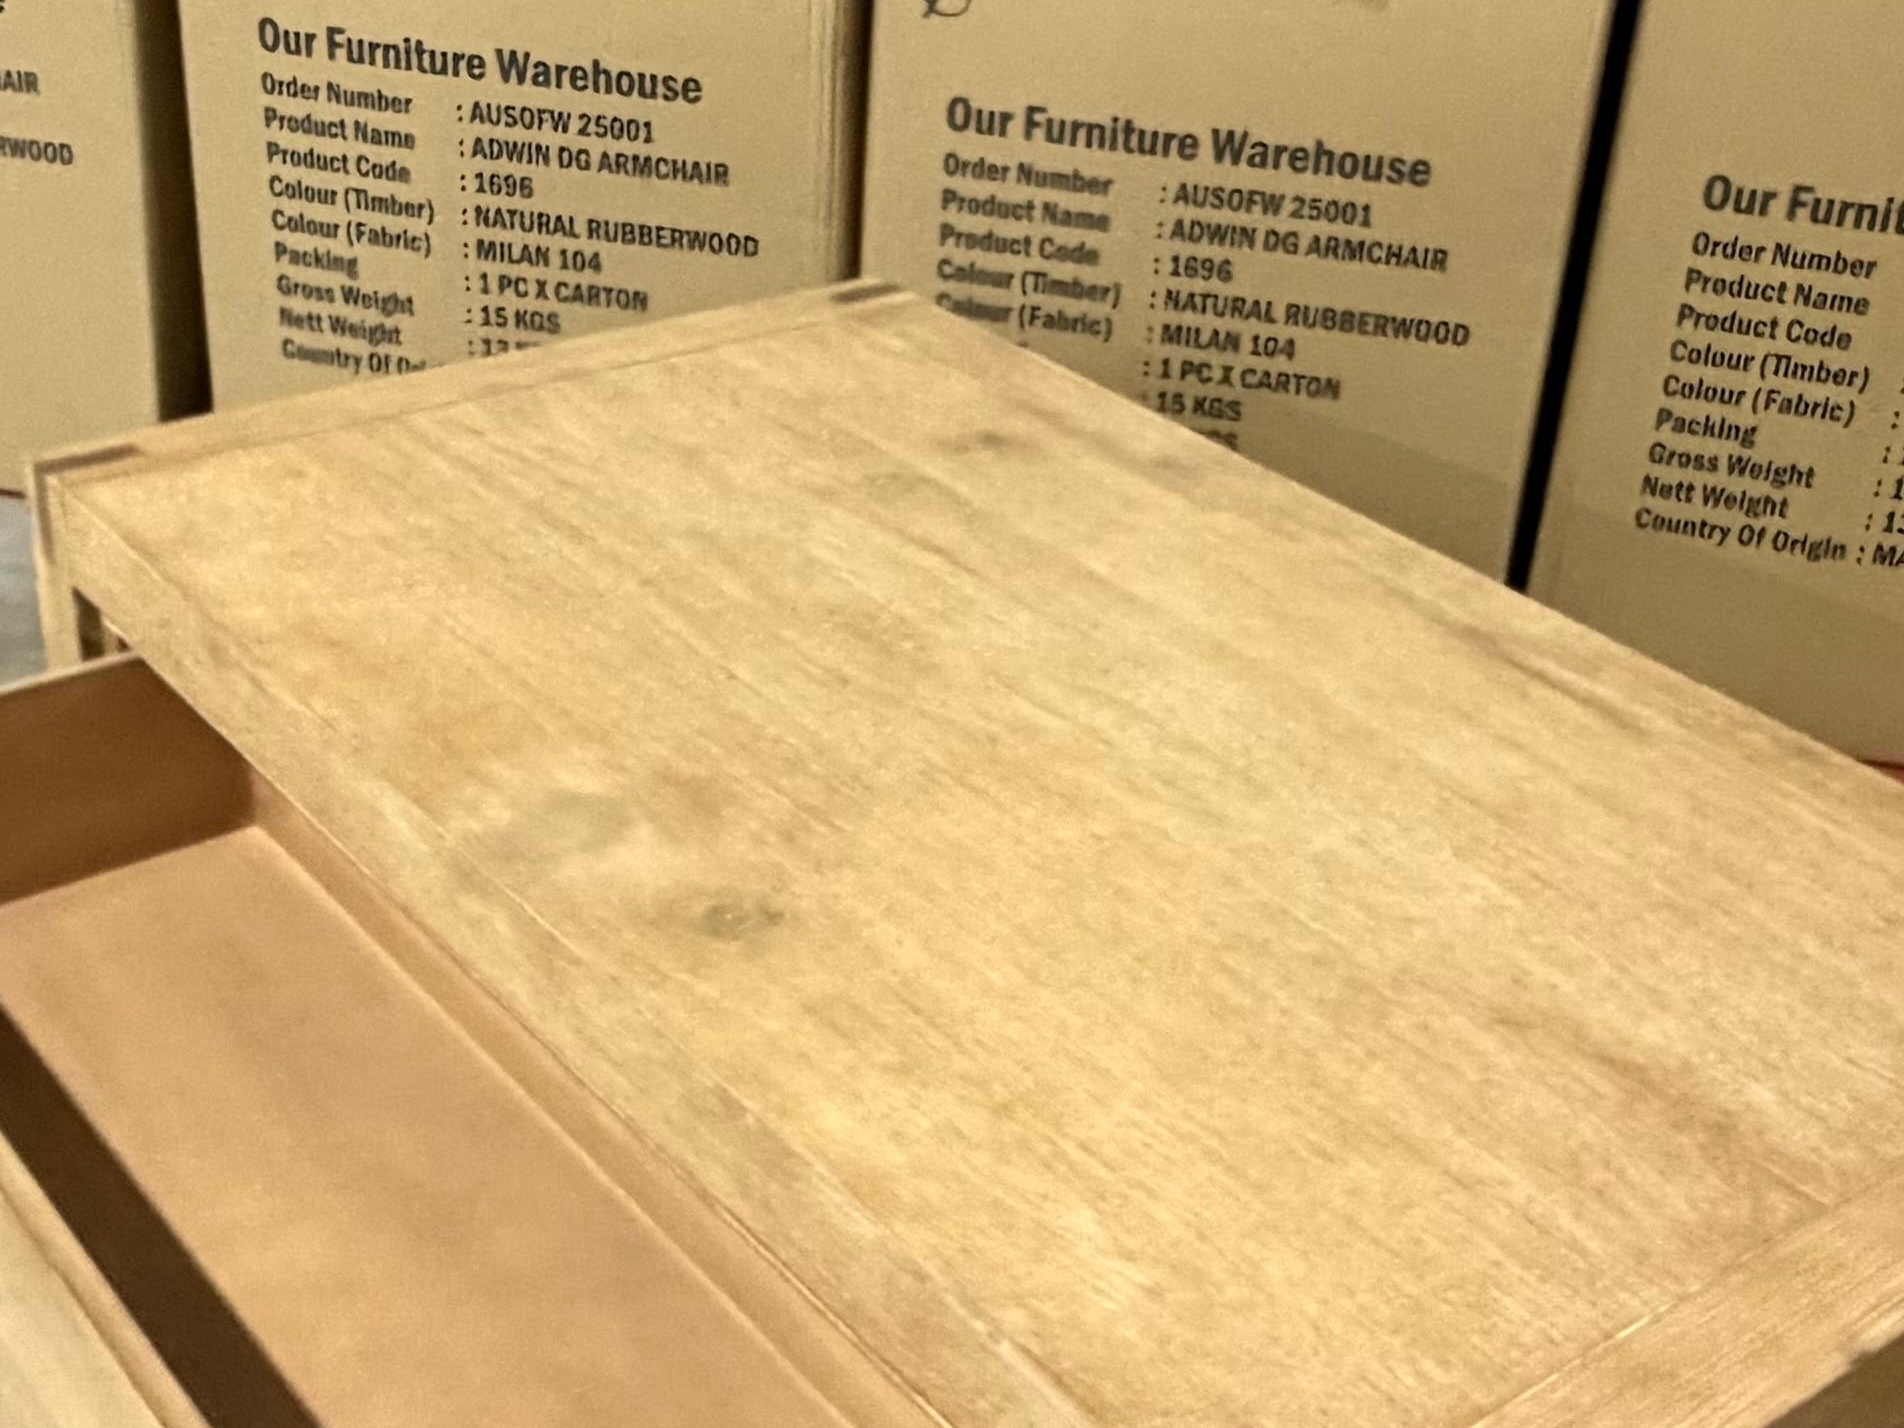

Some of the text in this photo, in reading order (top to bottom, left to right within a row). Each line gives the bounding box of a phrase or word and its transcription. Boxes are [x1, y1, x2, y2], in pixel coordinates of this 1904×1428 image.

[258, 19, 701, 104] Our Furniture Warehouse
[263, 108, 730, 187] Product Name ADWIN DG ARMCHAIR
[947, 98, 1431, 187] Our Furniture Warehouse
[1703, 175, 1779, 216] Our
[939, 223, 1232, 282] Product Code 1696
[1692, 232, 1767, 262] Order
[1771, 243, 1878, 278] Number
[1683, 268, 1787, 304] Product
[1793, 283, 1870, 315] Name
[1641, 476, 1695, 503] Nett
[1702, 485, 1789, 518] Weight
[1635, 508, 1732, 546] Country
[1737, 524, 1768, 548] Of
[1771, 530, 1846, 561] Origin
